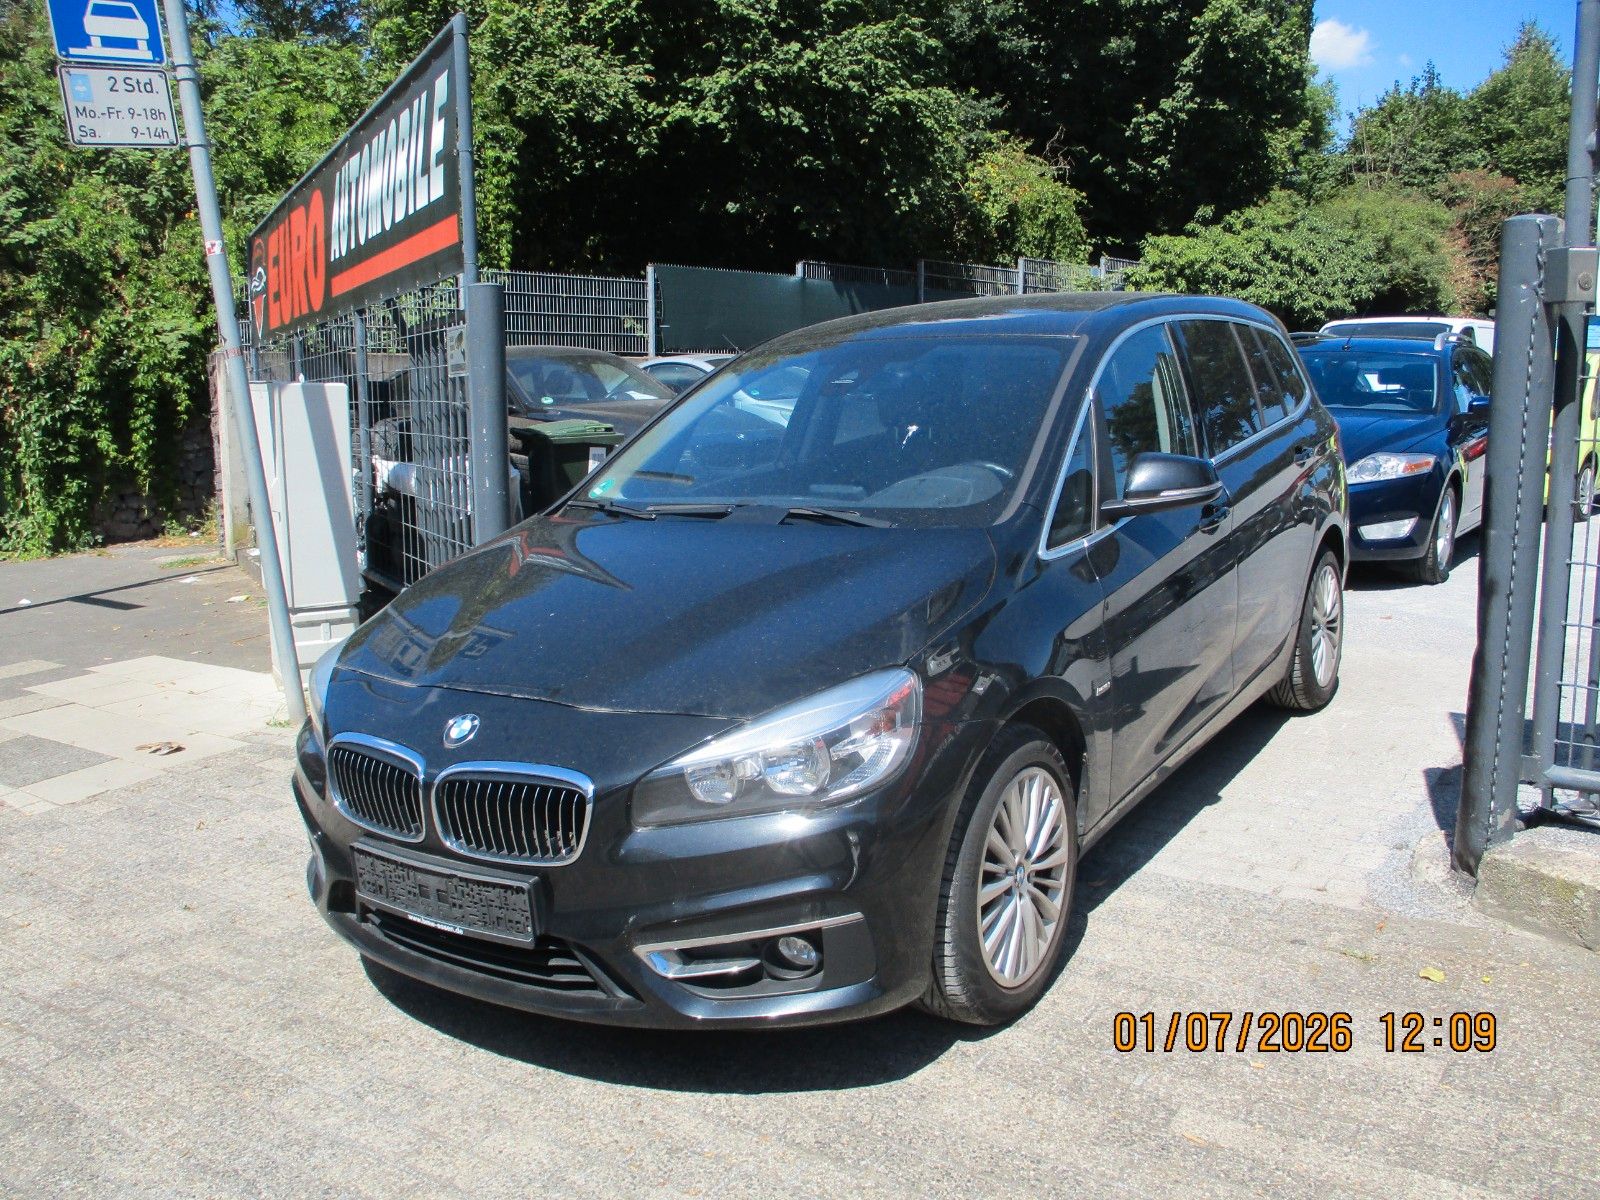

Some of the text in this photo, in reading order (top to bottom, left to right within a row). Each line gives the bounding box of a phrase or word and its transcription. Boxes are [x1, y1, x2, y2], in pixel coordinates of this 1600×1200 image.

[107, 76, 159, 95] 2 Std.
[75, 106, 167, 121] Mo.-Fr. 9-18h
[78, 125, 169, 140] Sa. 9-14h
[266, 68, 449, 330] EURO AUTOMOBILE
